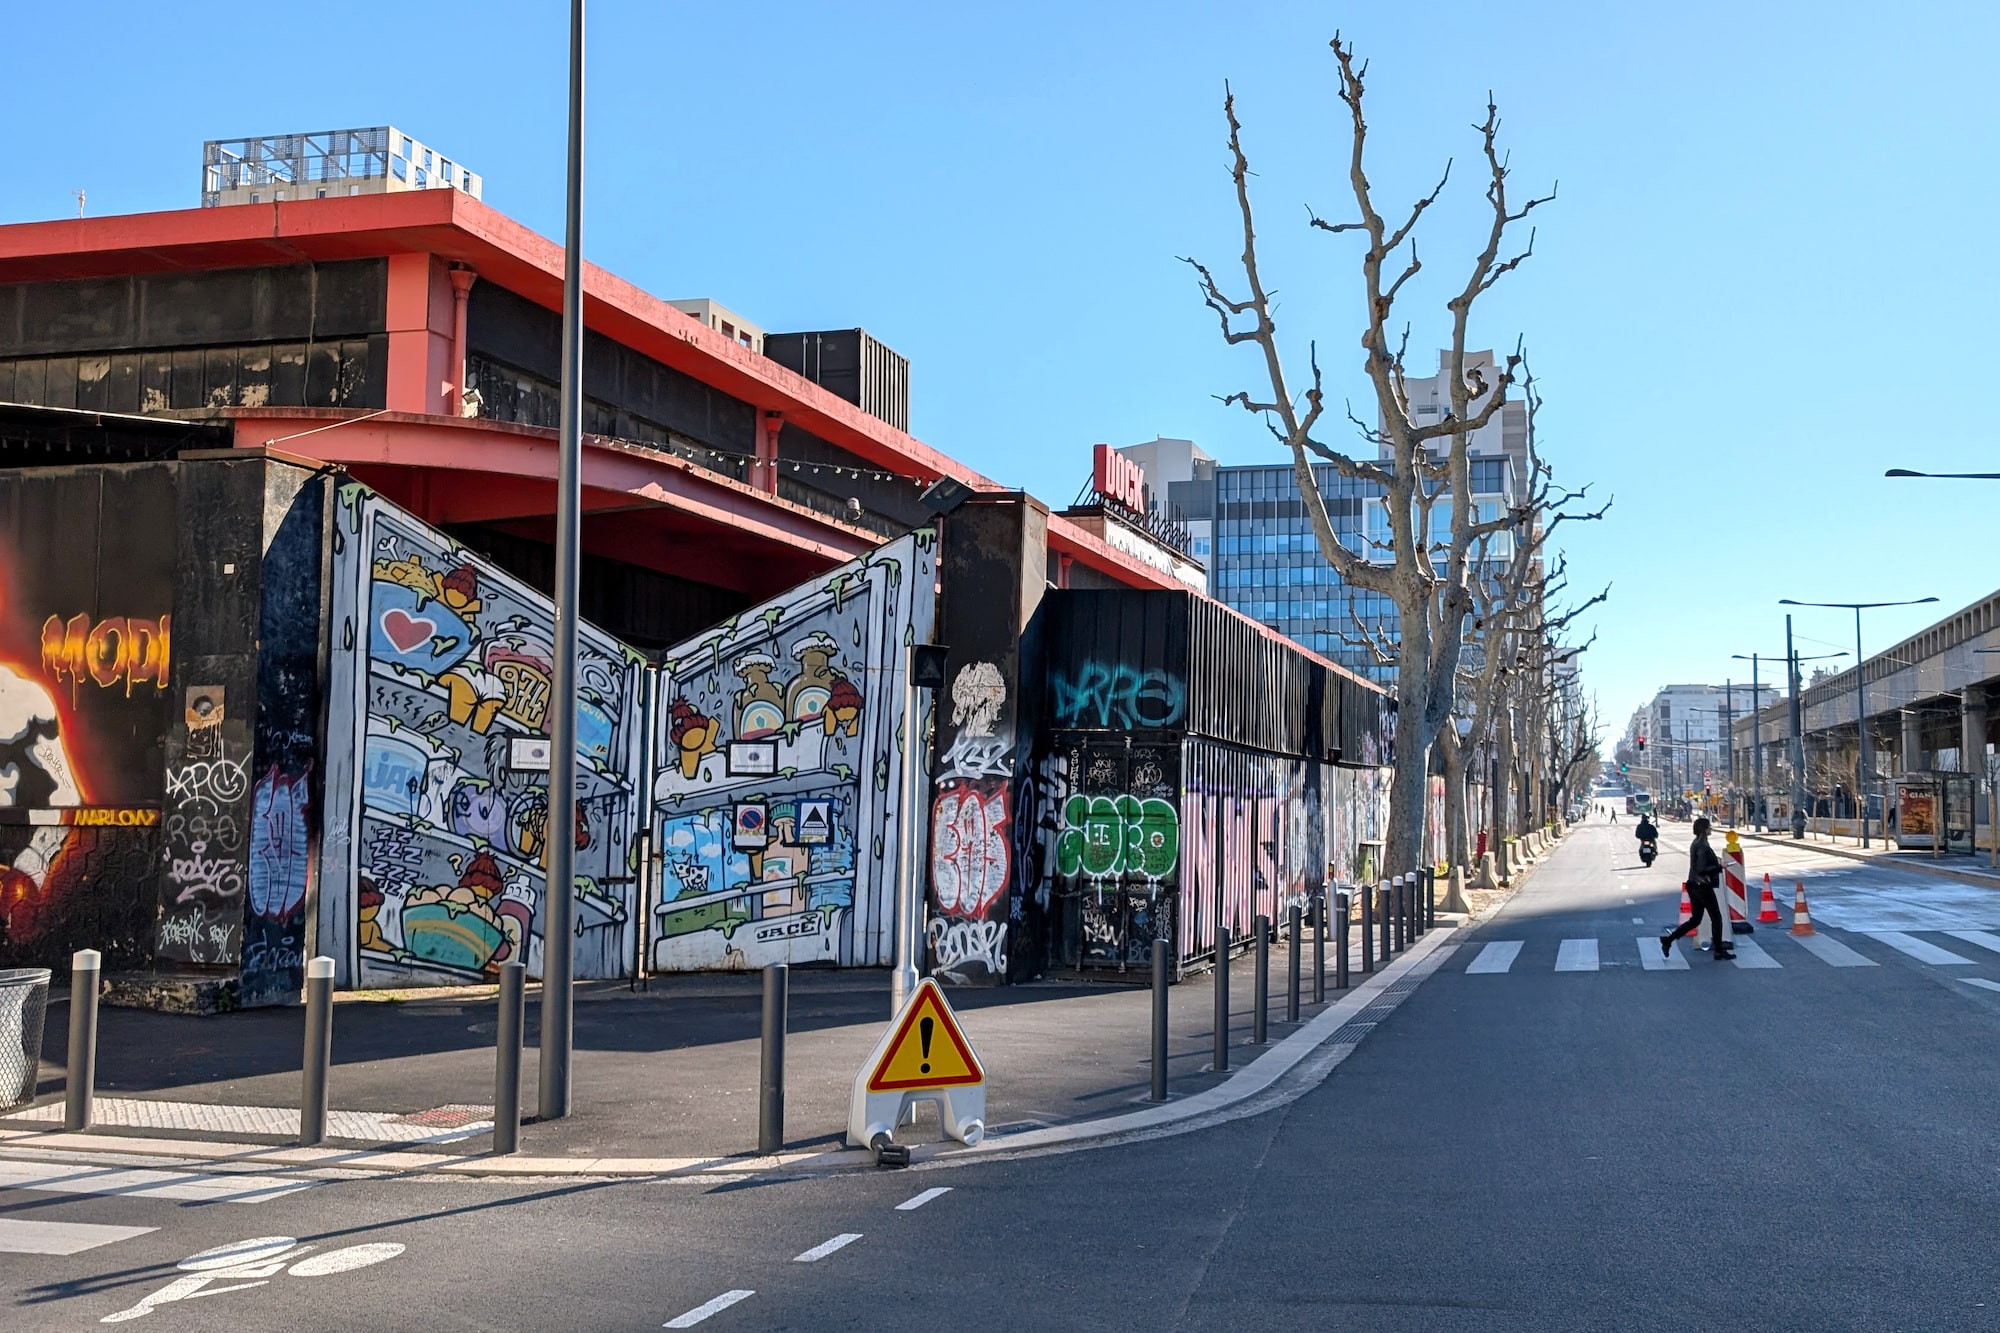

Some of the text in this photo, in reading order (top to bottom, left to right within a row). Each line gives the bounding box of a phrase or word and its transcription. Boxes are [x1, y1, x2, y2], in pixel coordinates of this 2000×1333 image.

[1105, 444, 1145, 515] DOCK
[500, 665, 548, 723] 974
[756, 920, 817, 940] JACE
